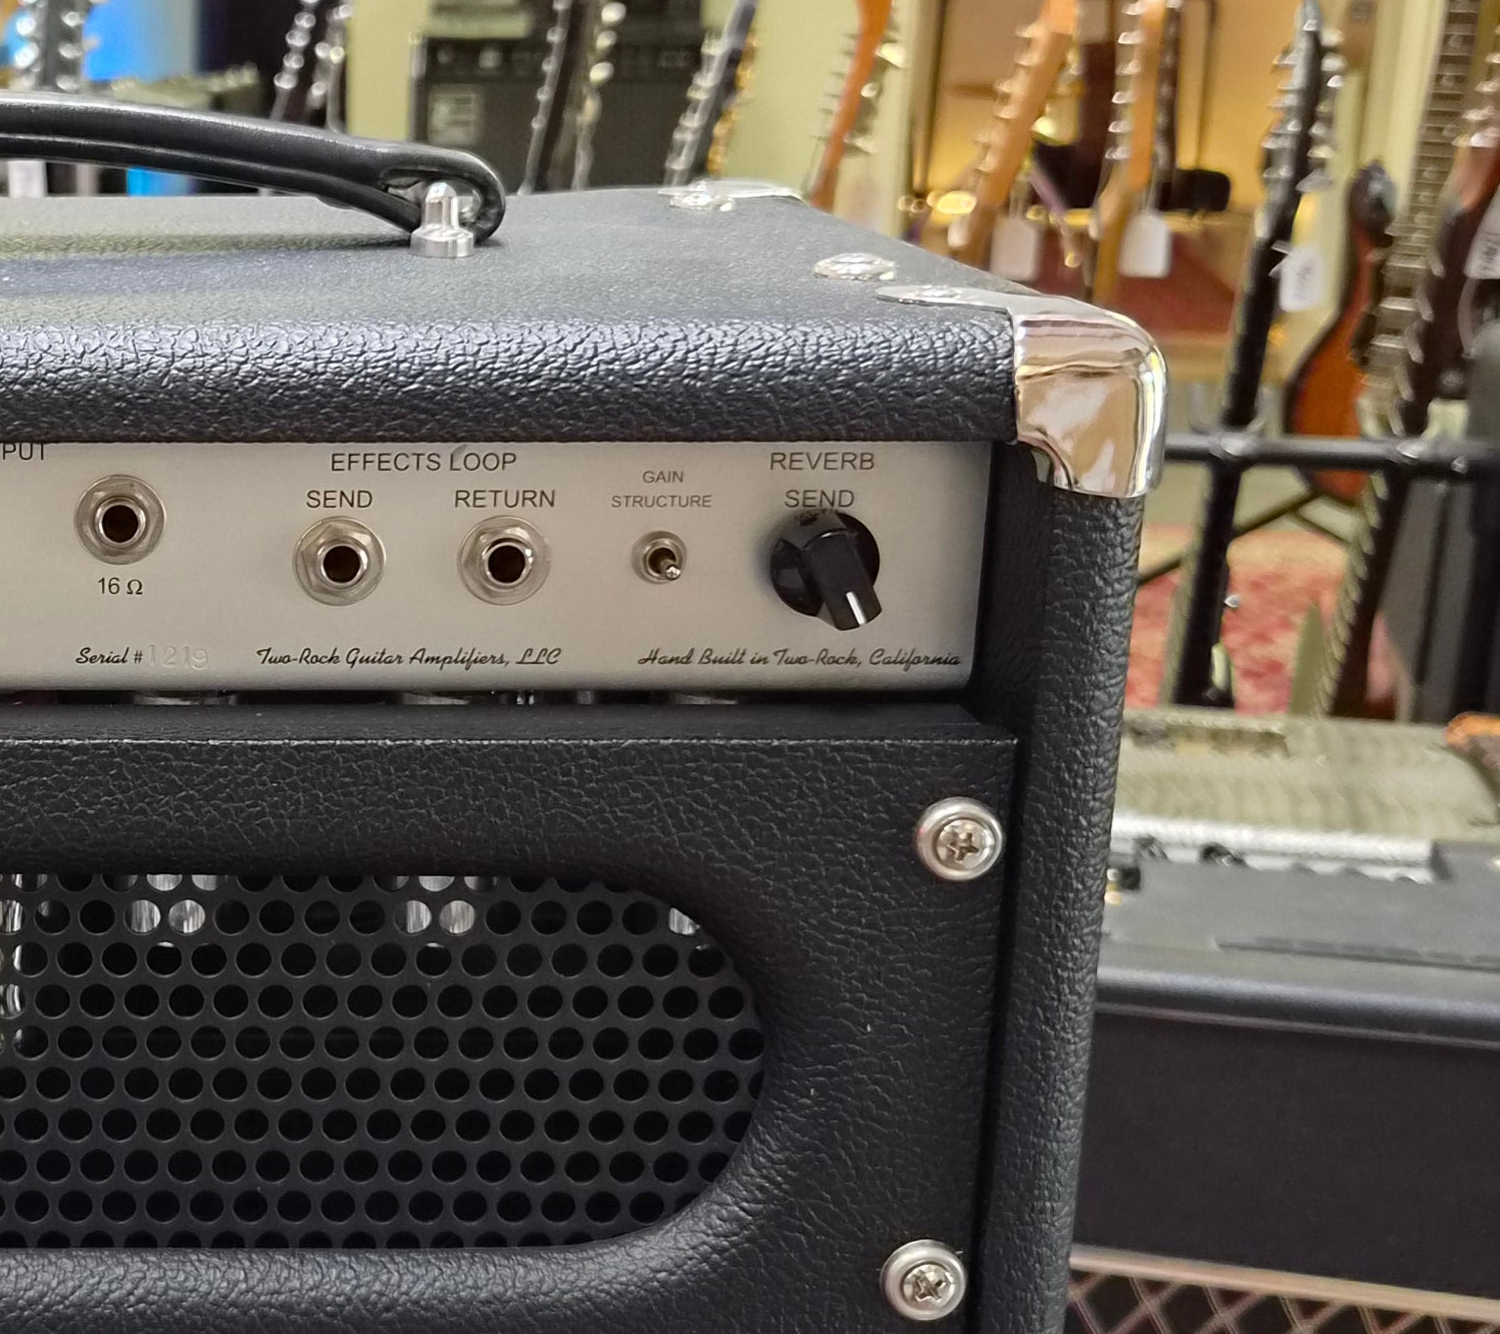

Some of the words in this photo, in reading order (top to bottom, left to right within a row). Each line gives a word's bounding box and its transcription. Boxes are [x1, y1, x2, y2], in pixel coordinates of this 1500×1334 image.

[331, 452, 441, 472] EFFECTS
[449, 452, 517, 472] LOOP
[770, 451, 875, 471] REVERB
[642, 470, 684, 484] GAIN
[306, 490, 373, 509] SEND
[454, 489, 556, 509] RETURN
[611, 494, 712, 509] STRUCTURE
[784, 489, 855, 509] SEND
[97, 576, 121, 595] 16
[75, 646, 130, 664] Serial
[133, 650, 143, 664] #
[257, 647, 340, 665] Two-Rock
[345, 647, 404, 668] Guitar
[408, 647, 510, 670] Amplifiers,
[515, 647, 562, 665] LLC
[637, 647, 695, 665] Hand
[698, 647, 747, 665] Built
[749, 648, 769, 665] in
[773, 647, 862, 668] Two-Rock,
[868, 647, 962, 672] California
